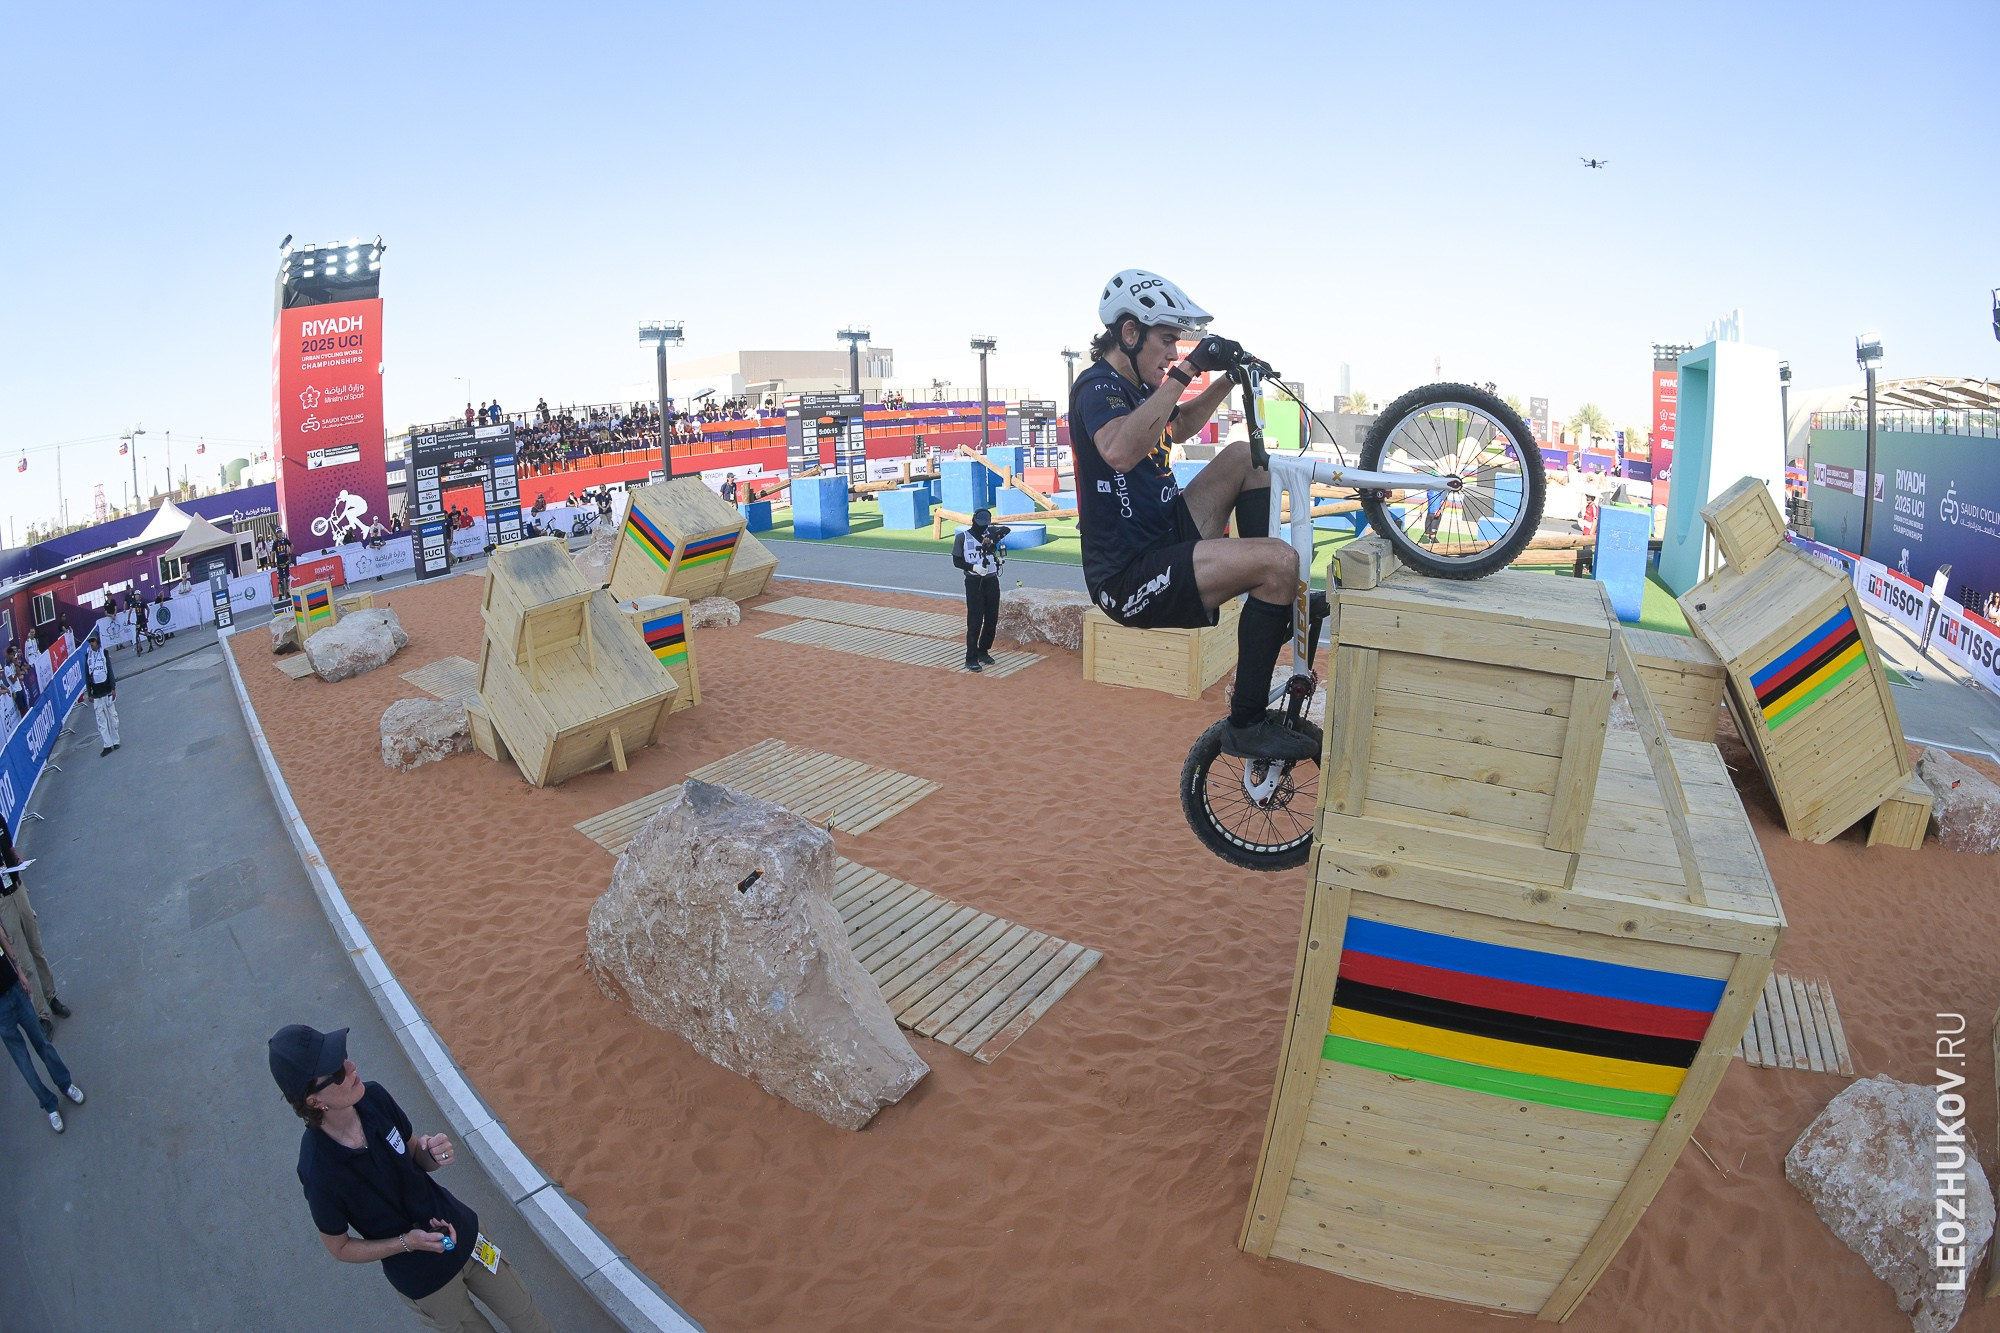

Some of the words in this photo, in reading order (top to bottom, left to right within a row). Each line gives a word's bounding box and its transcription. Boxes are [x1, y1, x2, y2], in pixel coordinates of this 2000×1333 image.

[1130, 280, 1163, 296] POC
[302, 315, 363, 338] RIYADH
[302, 338, 335, 353] 2025
[338, 334, 362, 348] UCI
[302, 354, 320, 362] URBAN
[320, 351, 344, 359] CYCLING
[302, 356, 363, 370] CHAMPIONSHIPS
[324, 385, 347, 396] الرياضة
[349, 384, 364, 392] وزارة
[350, 392, 364, 400] Sport
[322, 417, 339, 425] SAUDI
[340, 413, 364, 422] CYCLING
[420, 436, 436, 446] UCI
[310, 450, 323, 458] UCI
[454, 449, 477, 459] FINISH
[421, 467, 437, 477] UCI
[705, 472, 723, 480] RIYADH
[1895, 469, 1926, 495] RIYADH
[1894, 495, 1911, 514] 2025
[1911, 499, 1925, 518] UCI
[1960, 502, 1979, 518] SAUDI
[460, 536, 481, 544] CYCLING
[504, 532, 519, 541] UCI
[428, 548, 443, 557] UCI
[210, 570, 225, 578] START
[314, 564, 334, 574] RIYADH
[216, 576, 222, 589] 1
[1883, 582, 1923, 620] TISSOT
[26, 699, 55, 763] SHIMANO
